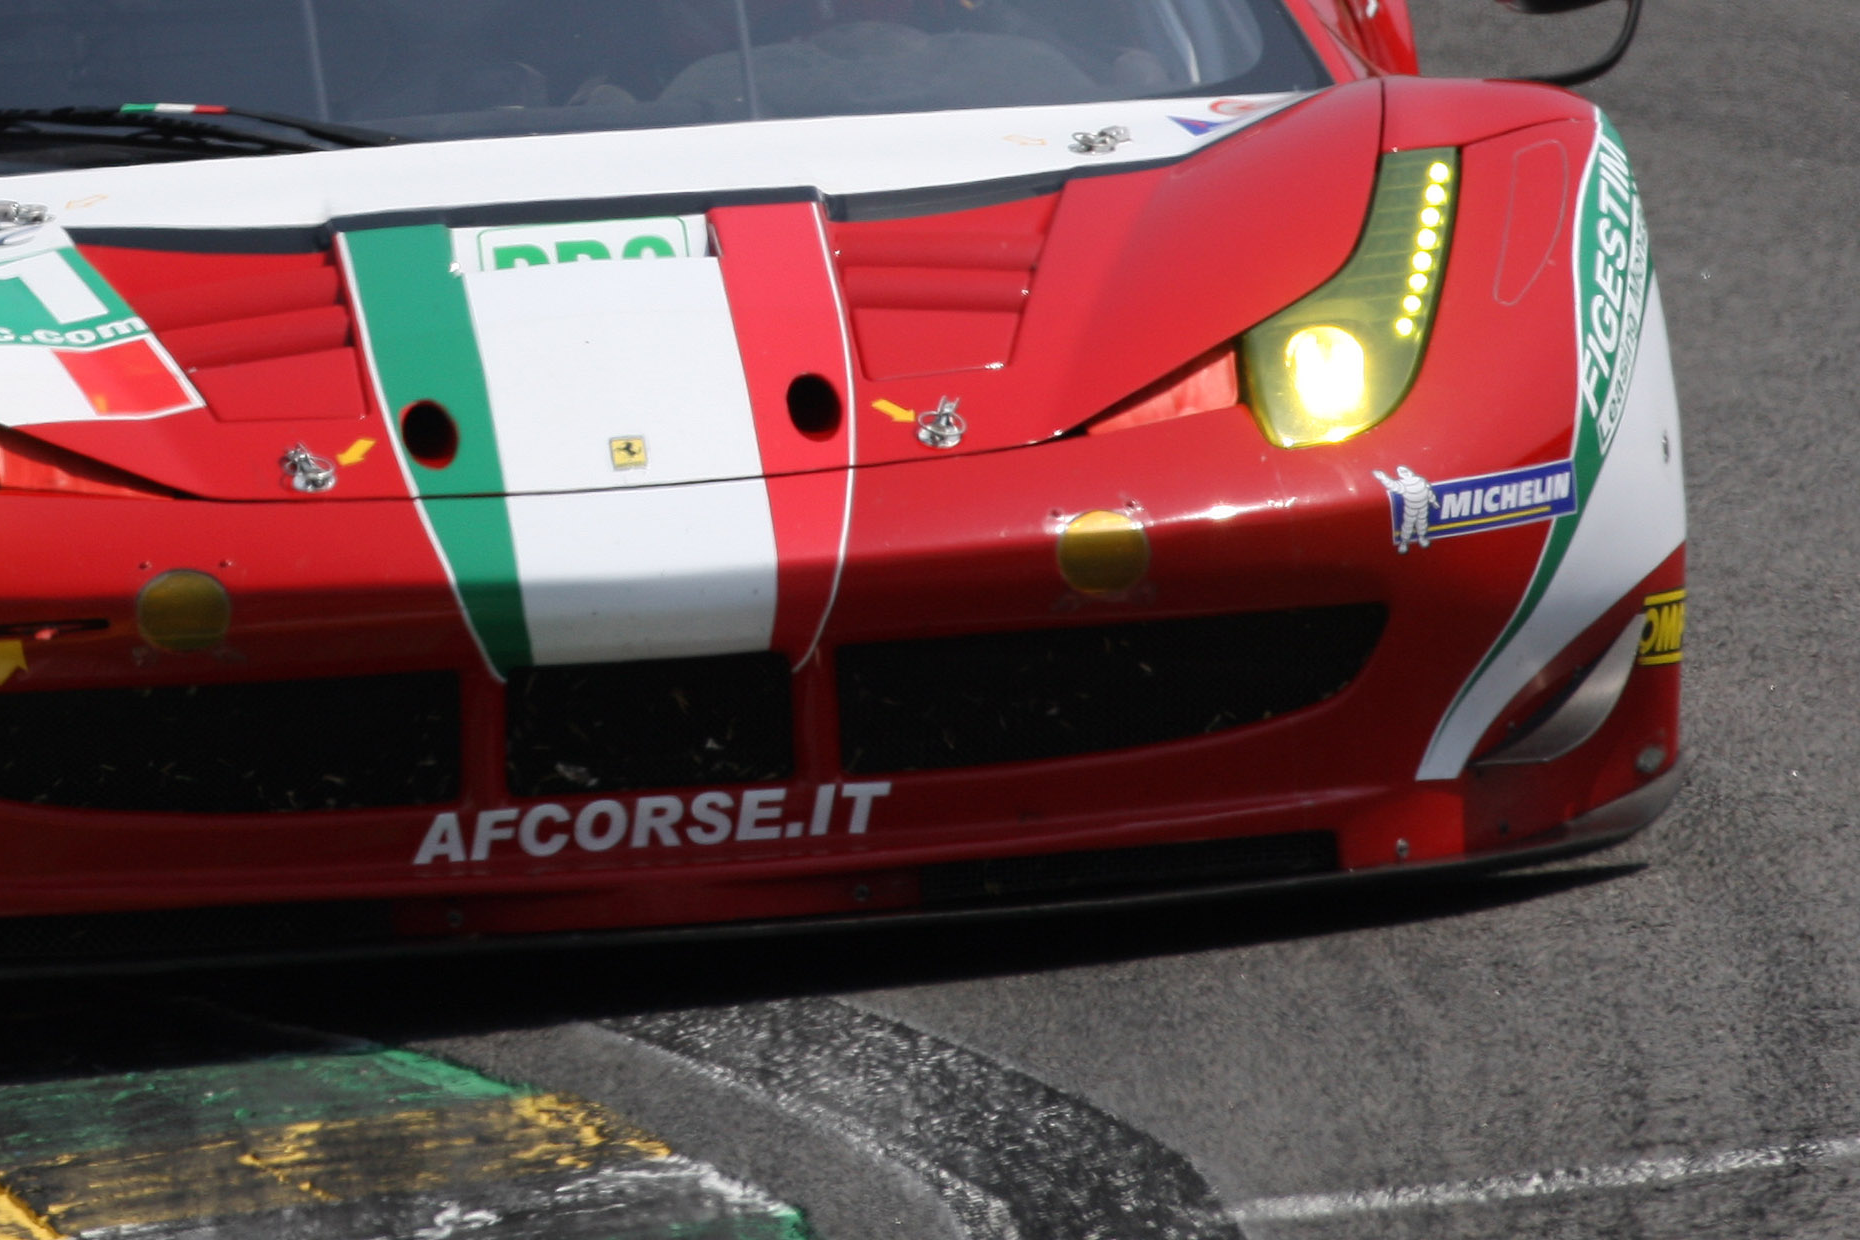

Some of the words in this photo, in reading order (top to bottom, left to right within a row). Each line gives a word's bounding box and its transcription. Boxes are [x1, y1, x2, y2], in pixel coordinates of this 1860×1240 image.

[1578, 133, 1634, 418] FIGESTIM
[1440, 471, 1571, 520] MICHELIN
[412, 781, 893, 866] AFCORSE.IT
